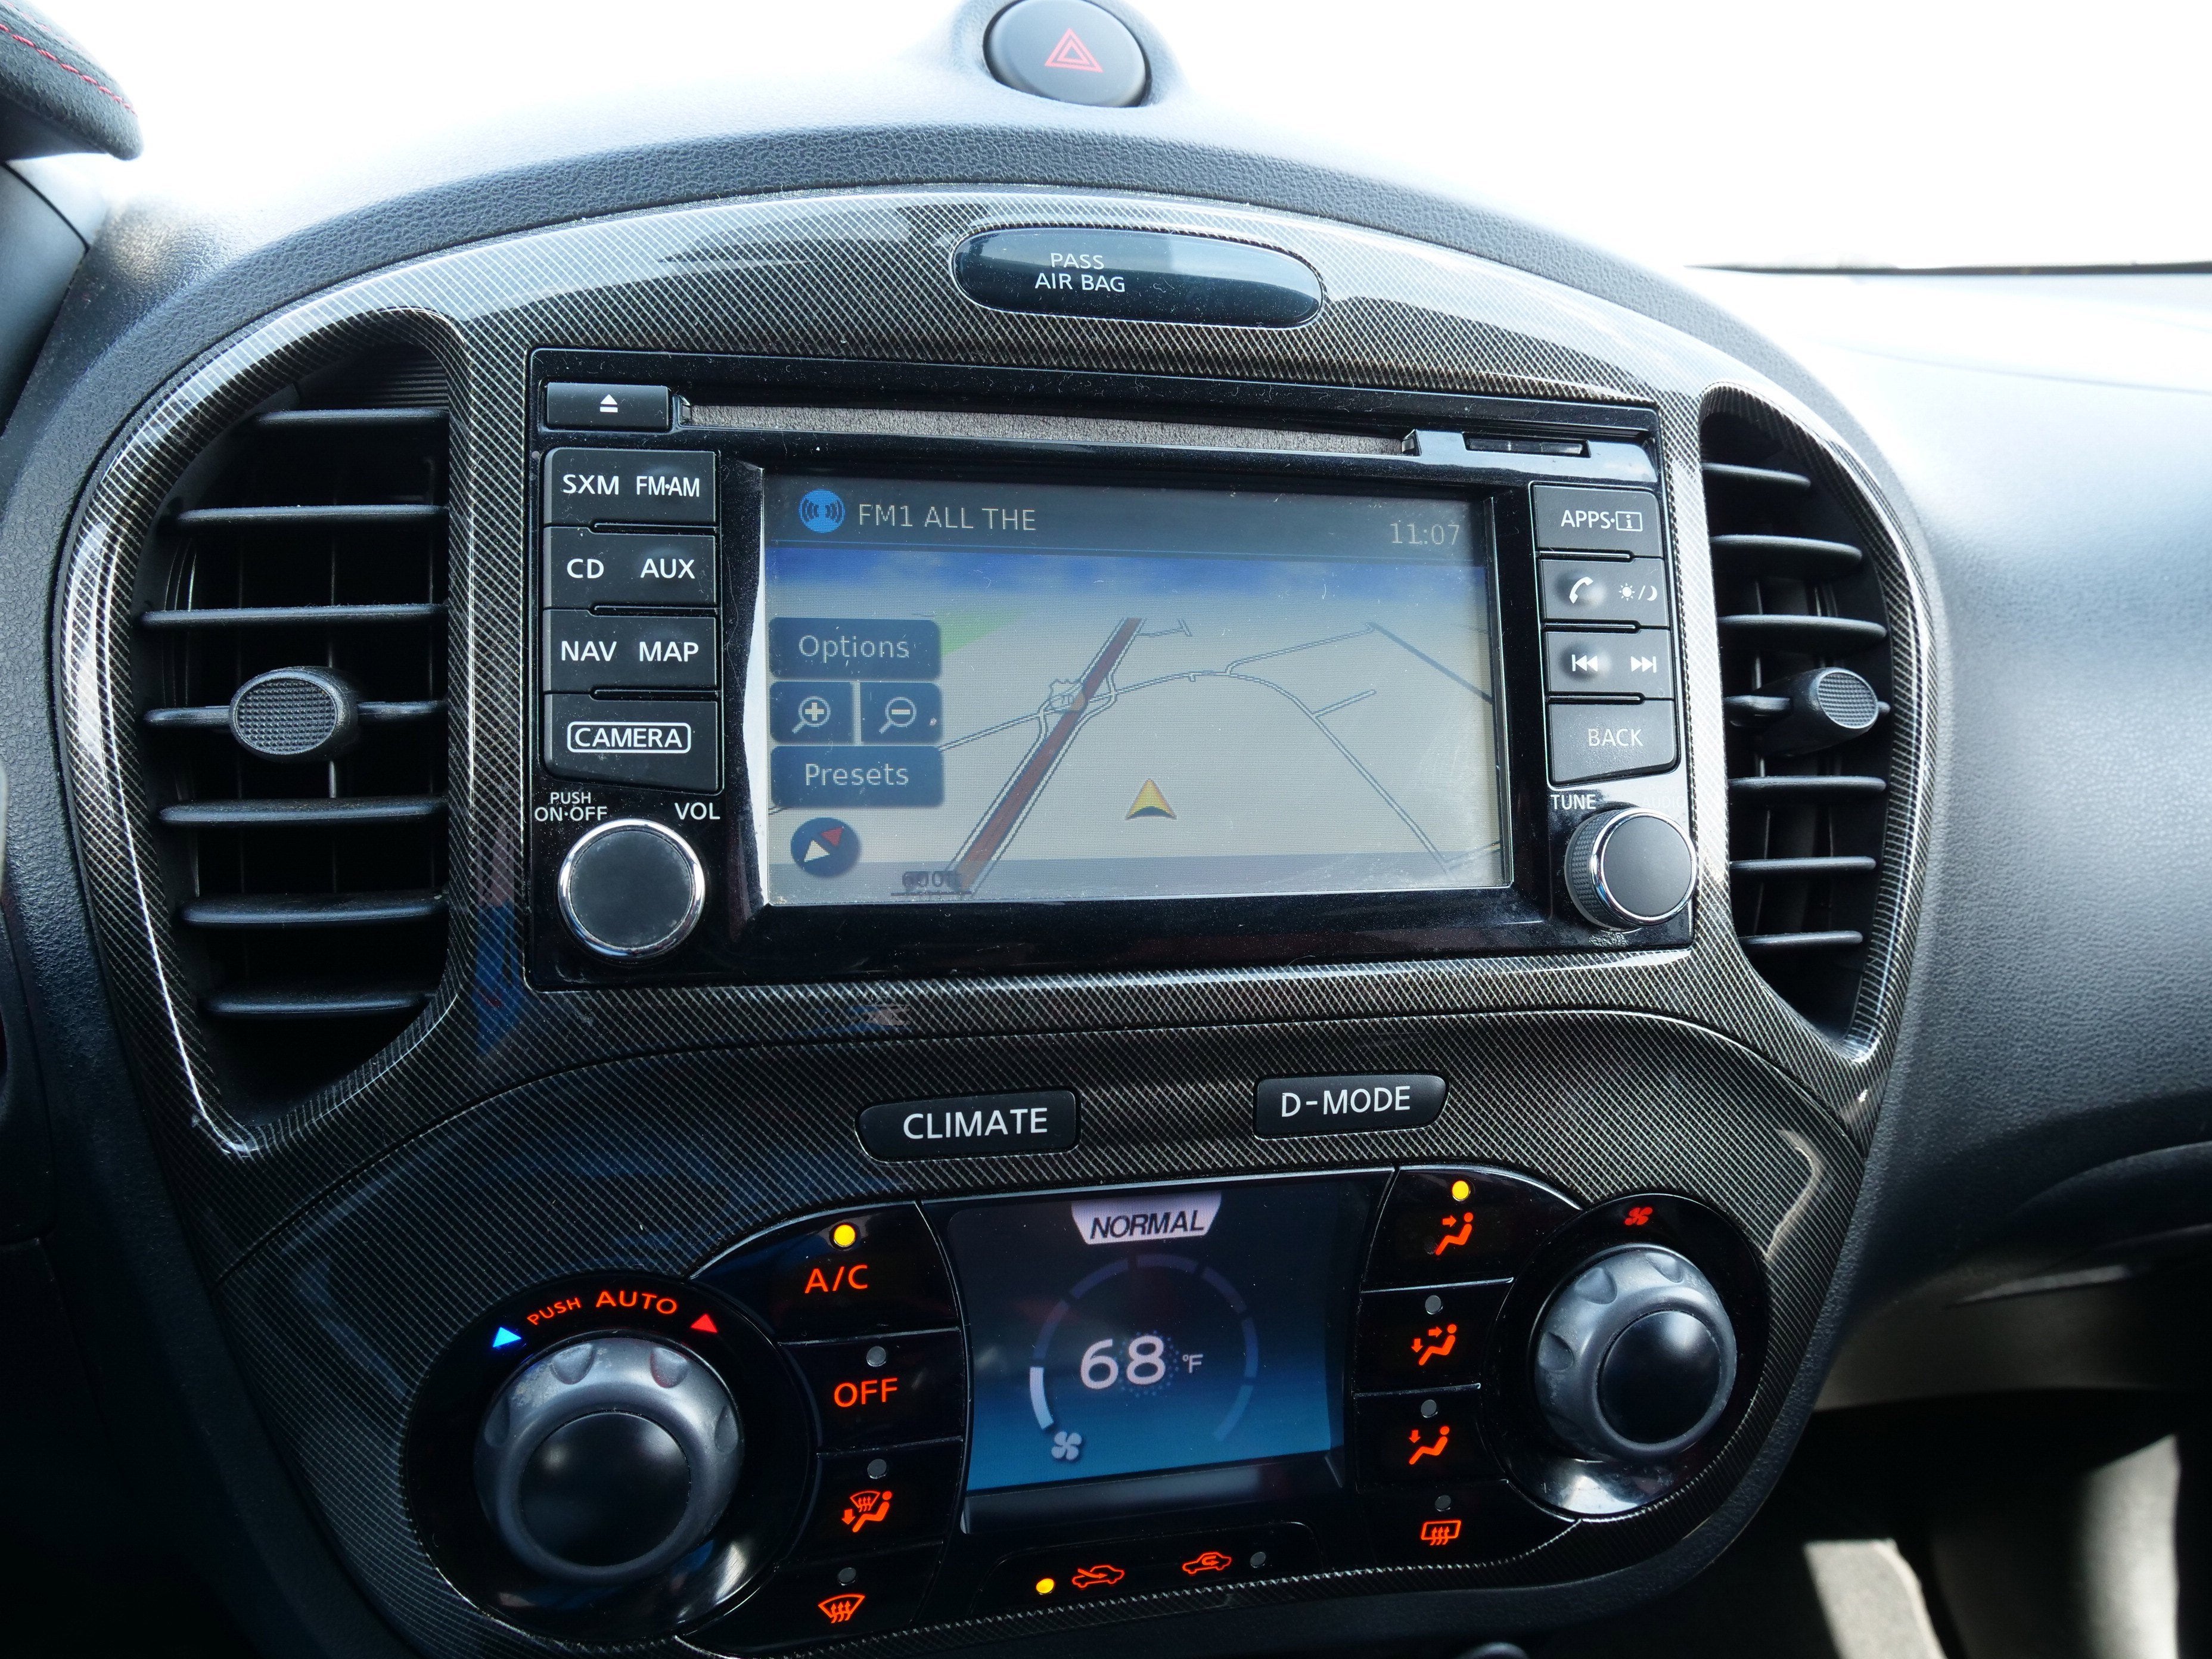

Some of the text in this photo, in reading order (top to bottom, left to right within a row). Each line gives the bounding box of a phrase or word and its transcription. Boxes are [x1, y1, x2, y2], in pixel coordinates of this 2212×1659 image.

[1050, 253, 1104, 270] PASS
[1034, 272, 1125, 293] AIR BAG
[563, 474, 619, 495] SXM
[859, 504, 1036, 530] FM1 ALL THE
[1390, 522, 1460, 545] 11:07
[567, 558, 605, 579] CD
[639, 558, 695, 579] AUX
[561, 641, 617, 661] NAV
[639, 641, 699, 662] MAP
[799, 635, 909, 663] Options
[574, 727, 683, 748] CAMERA
[1588, 728, 1644, 747] BACK
[806, 763, 909, 786] Presets
[550, 791, 591, 804] PUSH
[1550, 794, 1596, 810] TUNE
[675, 802, 720, 820] VOL
[1281, 1085, 1411, 1118] D-MODE
[903, 1107, 1048, 1140] CLIMATE
[1090, 1209, 1205, 1239] NORMAL
[805, 1264, 869, 1294] A/C
[527, 1291, 678, 1326] PUSH AUTO
[1080, 1335, 1166, 1390] 68
[834, 1377, 898, 1408] OFF
